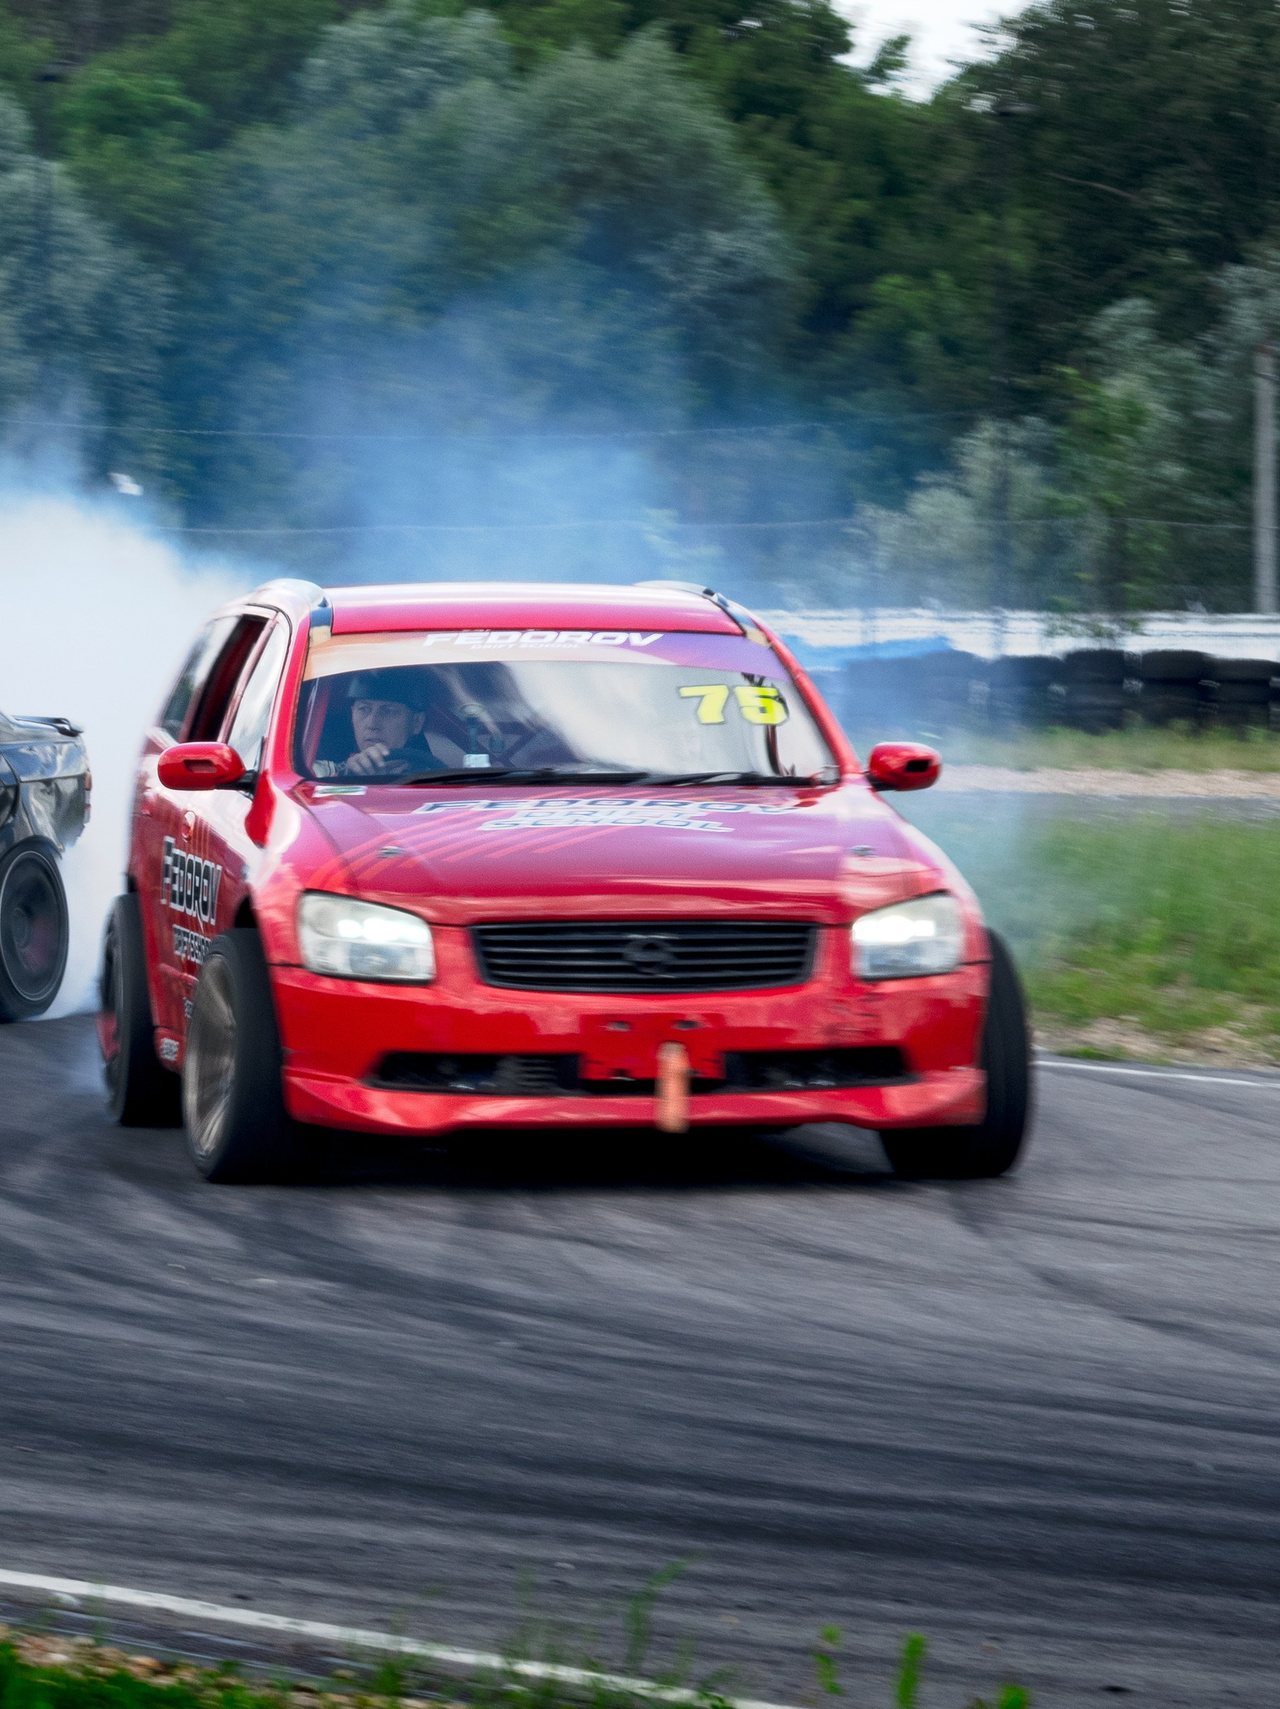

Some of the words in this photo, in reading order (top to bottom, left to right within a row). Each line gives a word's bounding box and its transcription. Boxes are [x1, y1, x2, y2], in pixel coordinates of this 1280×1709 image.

[423, 631, 664, 647] FEDOROV
[679, 684, 790, 725] 75
[412, 798, 800, 815] FEDOROV
[519, 809, 699, 819] DRIFT
[482, 817, 734, 832] SCHOOL
[160, 835, 223, 932] FEDOROV
